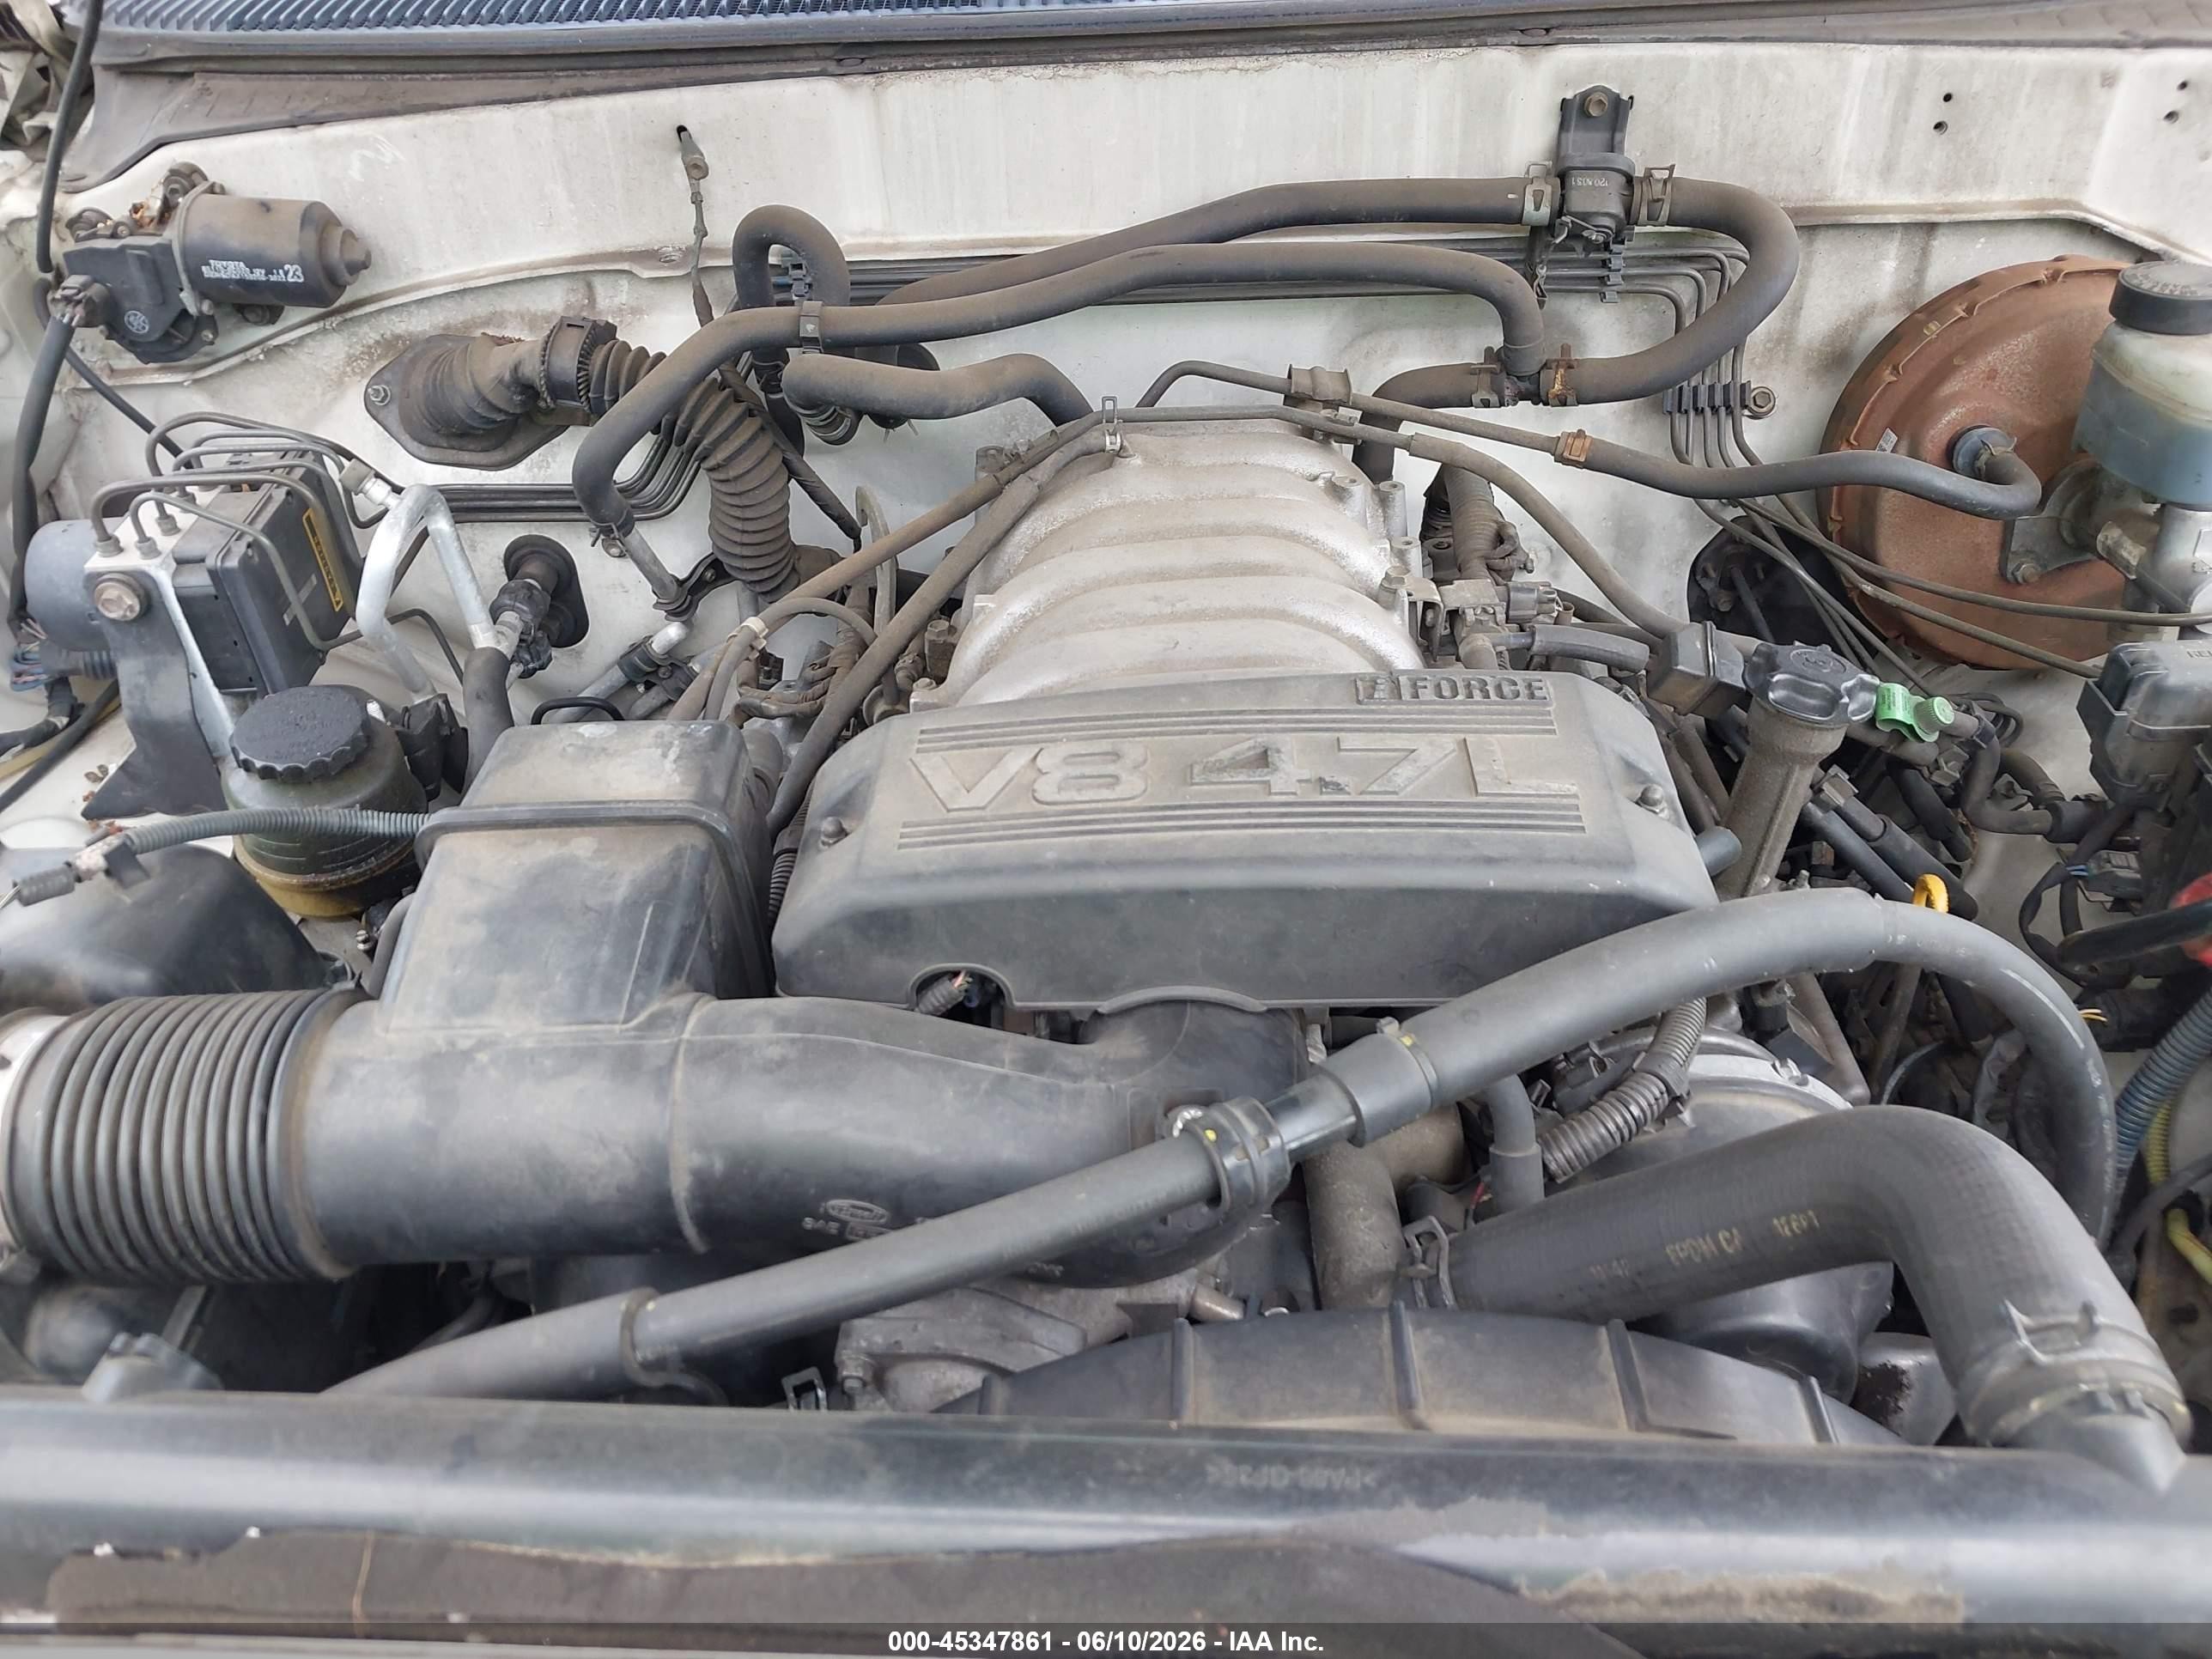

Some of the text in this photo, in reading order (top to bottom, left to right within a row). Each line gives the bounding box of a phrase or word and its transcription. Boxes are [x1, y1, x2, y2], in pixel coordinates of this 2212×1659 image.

[283, 264, 304, 283] 23
[1407, 675, 1548, 701] FORCE
[909, 736, 1581, 811] V8 4.7L
